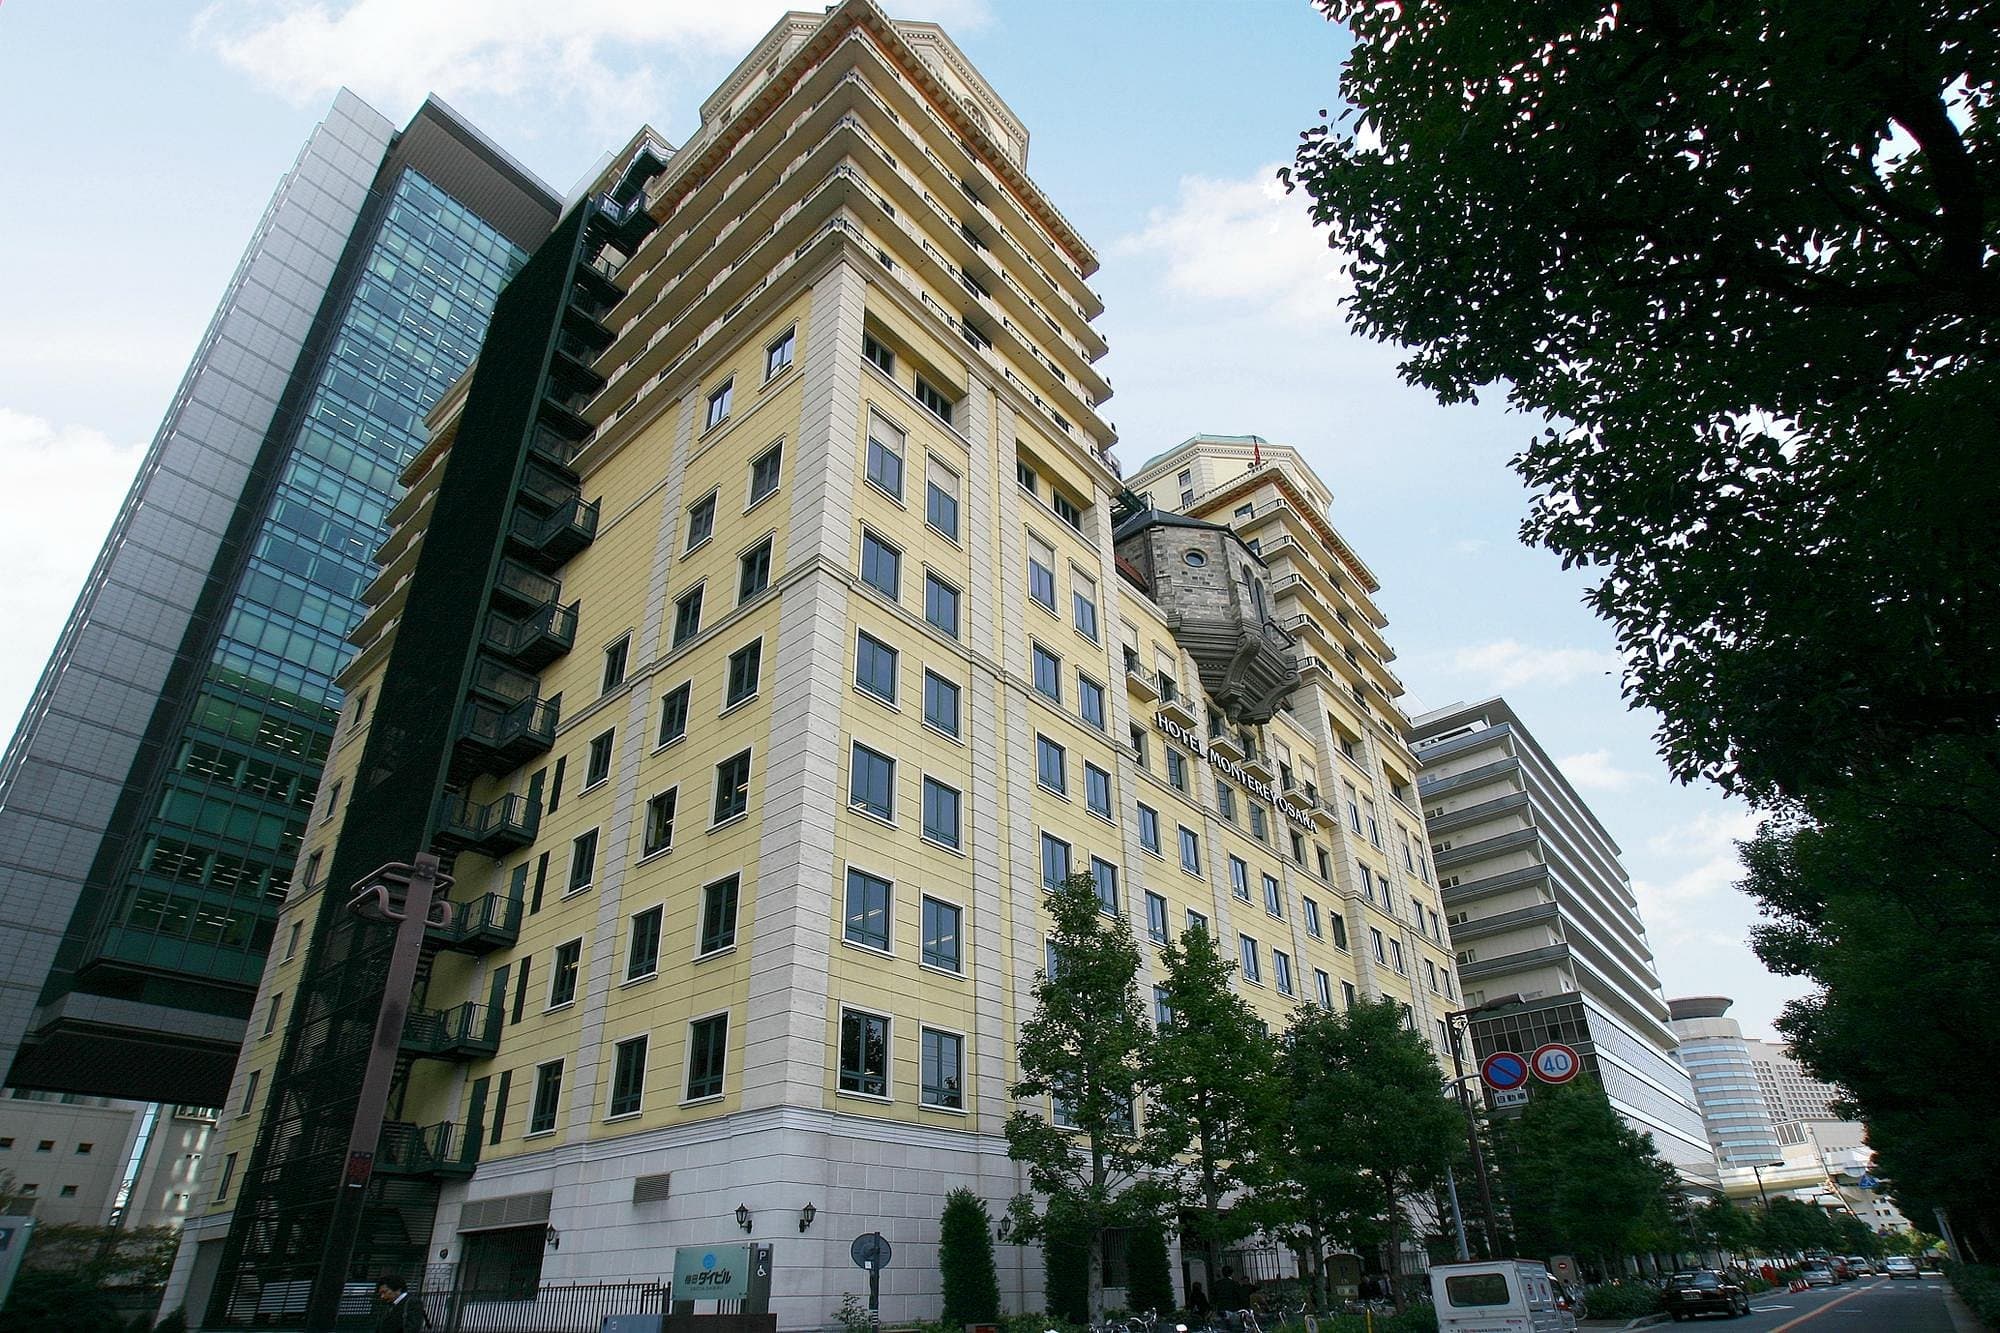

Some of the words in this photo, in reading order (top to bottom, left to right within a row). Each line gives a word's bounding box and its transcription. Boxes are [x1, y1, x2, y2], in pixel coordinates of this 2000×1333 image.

[1157, 712, 1207, 758] HOTEL
[1209, 748, 1277, 806] MONTEREY
[1278, 797, 1319, 835] OSAKA
[1543, 1054, 1569, 1073] 40
[759, 1251, 766, 1260] P
